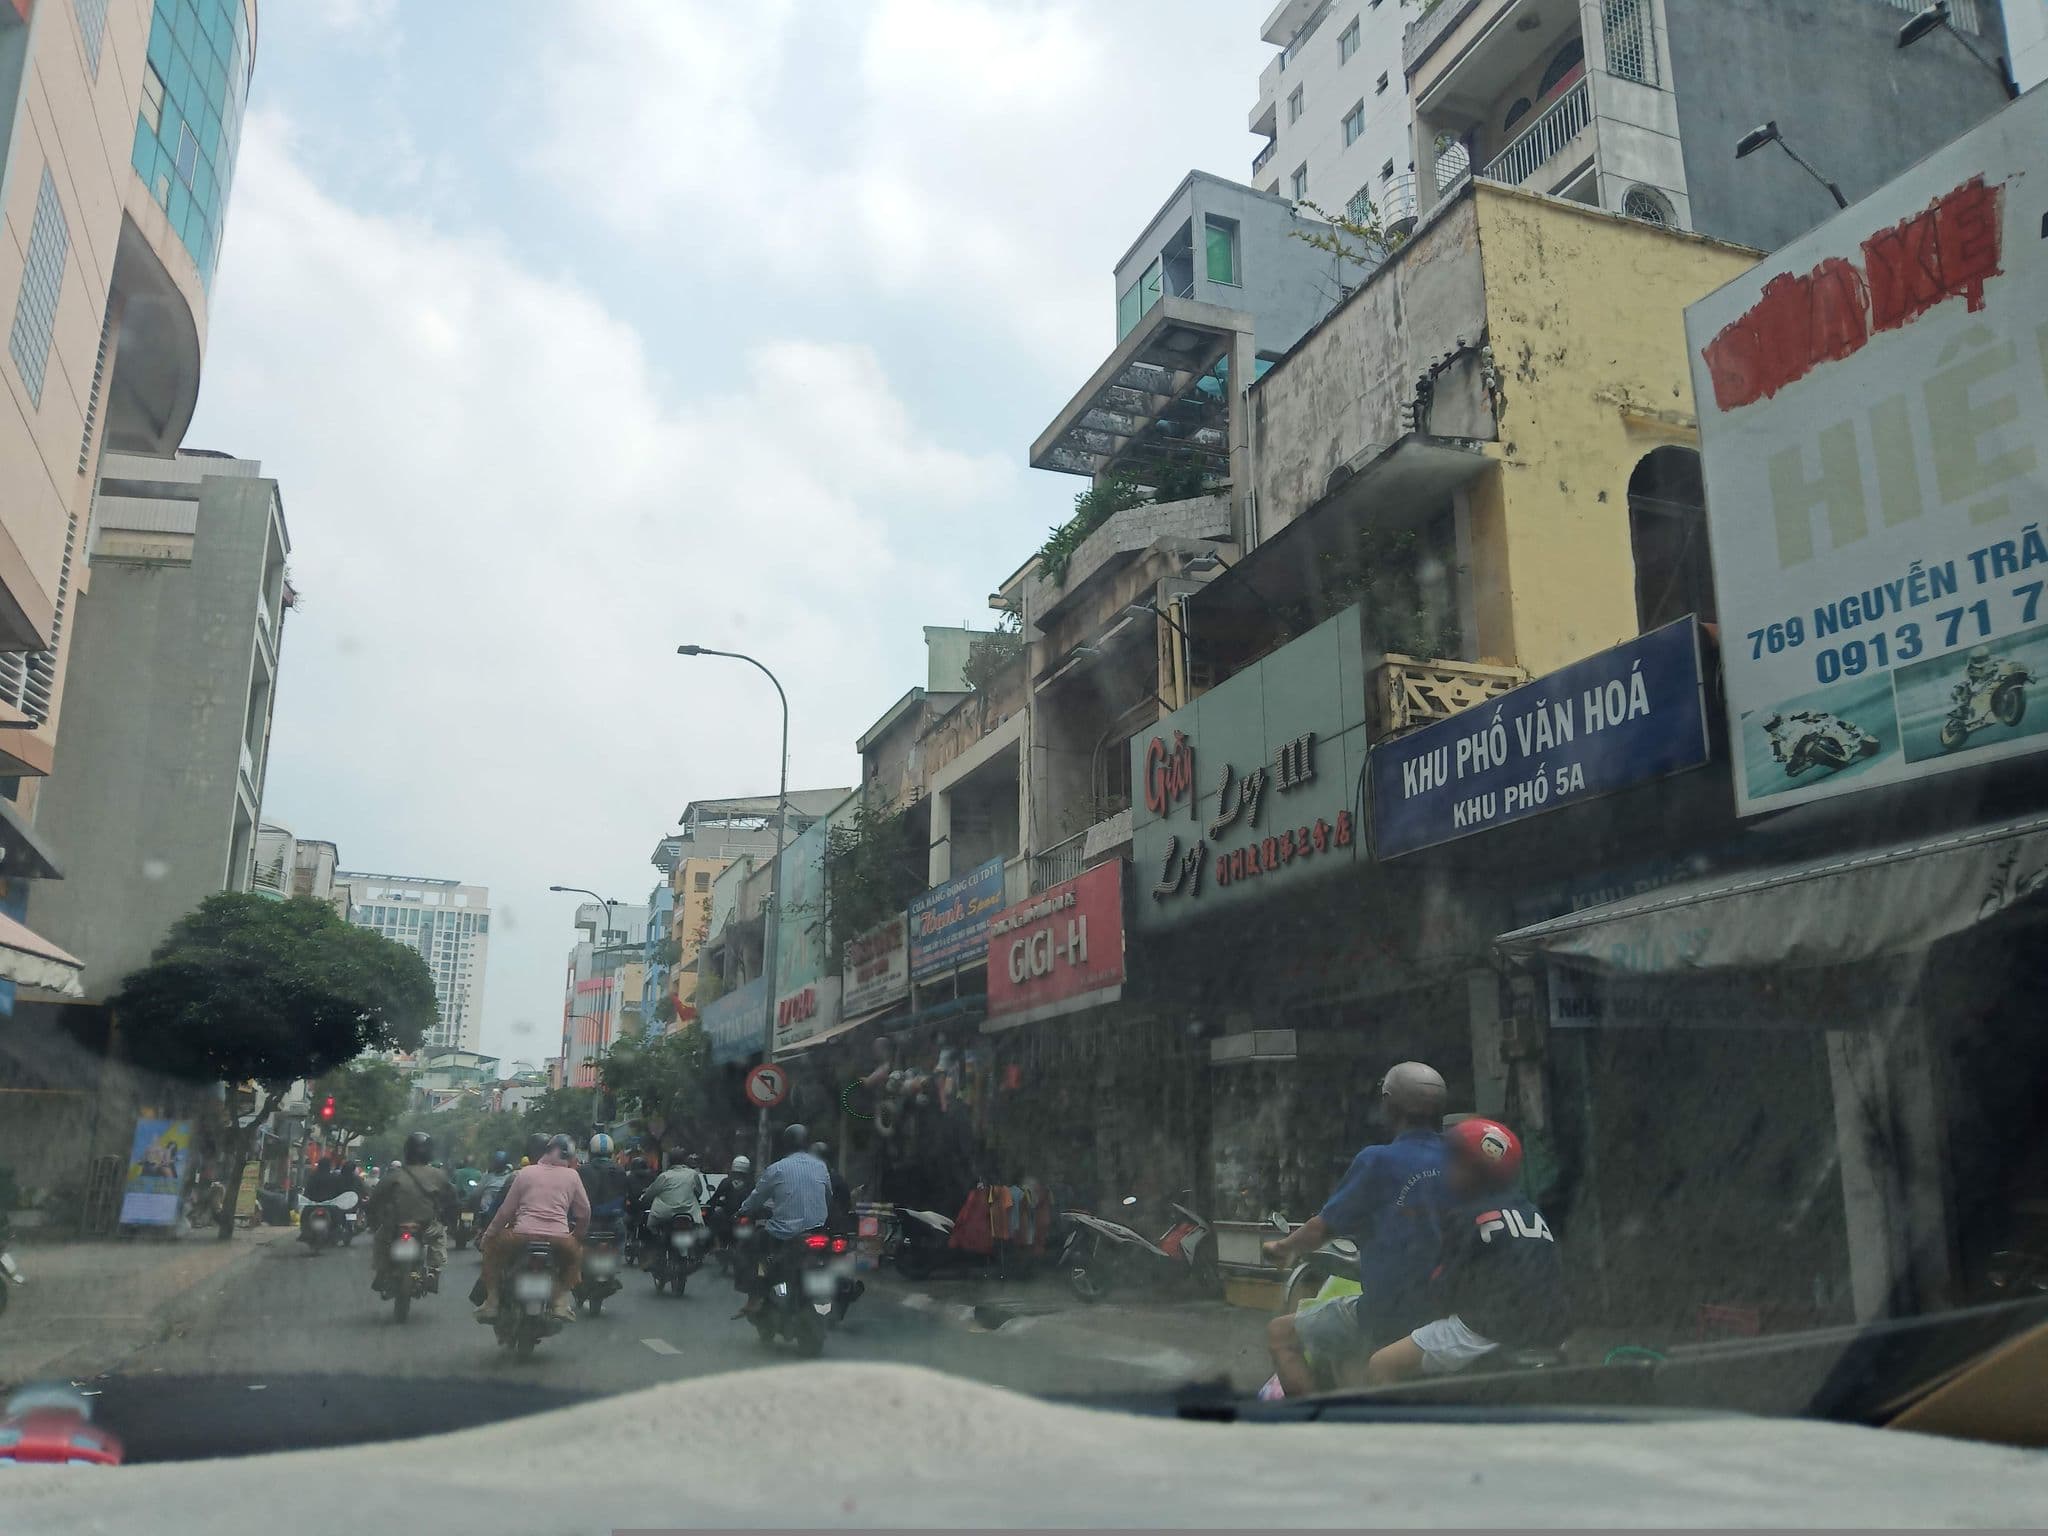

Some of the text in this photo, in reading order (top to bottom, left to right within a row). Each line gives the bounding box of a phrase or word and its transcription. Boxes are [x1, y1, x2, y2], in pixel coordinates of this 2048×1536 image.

[1769, 322, 2048, 570] HIỆ
[1747, 522, 2048, 660] 769 NGUYỄN TRÃ
[1816, 580, 2048, 684] 0913 71 7
[1403, 658, 1651, 799] KHU PHỐ VĂN HOÁ
[1453, 762, 1585, 828] KHU PHỐ 5A
[1475, 1208, 1555, 1243] FILA
